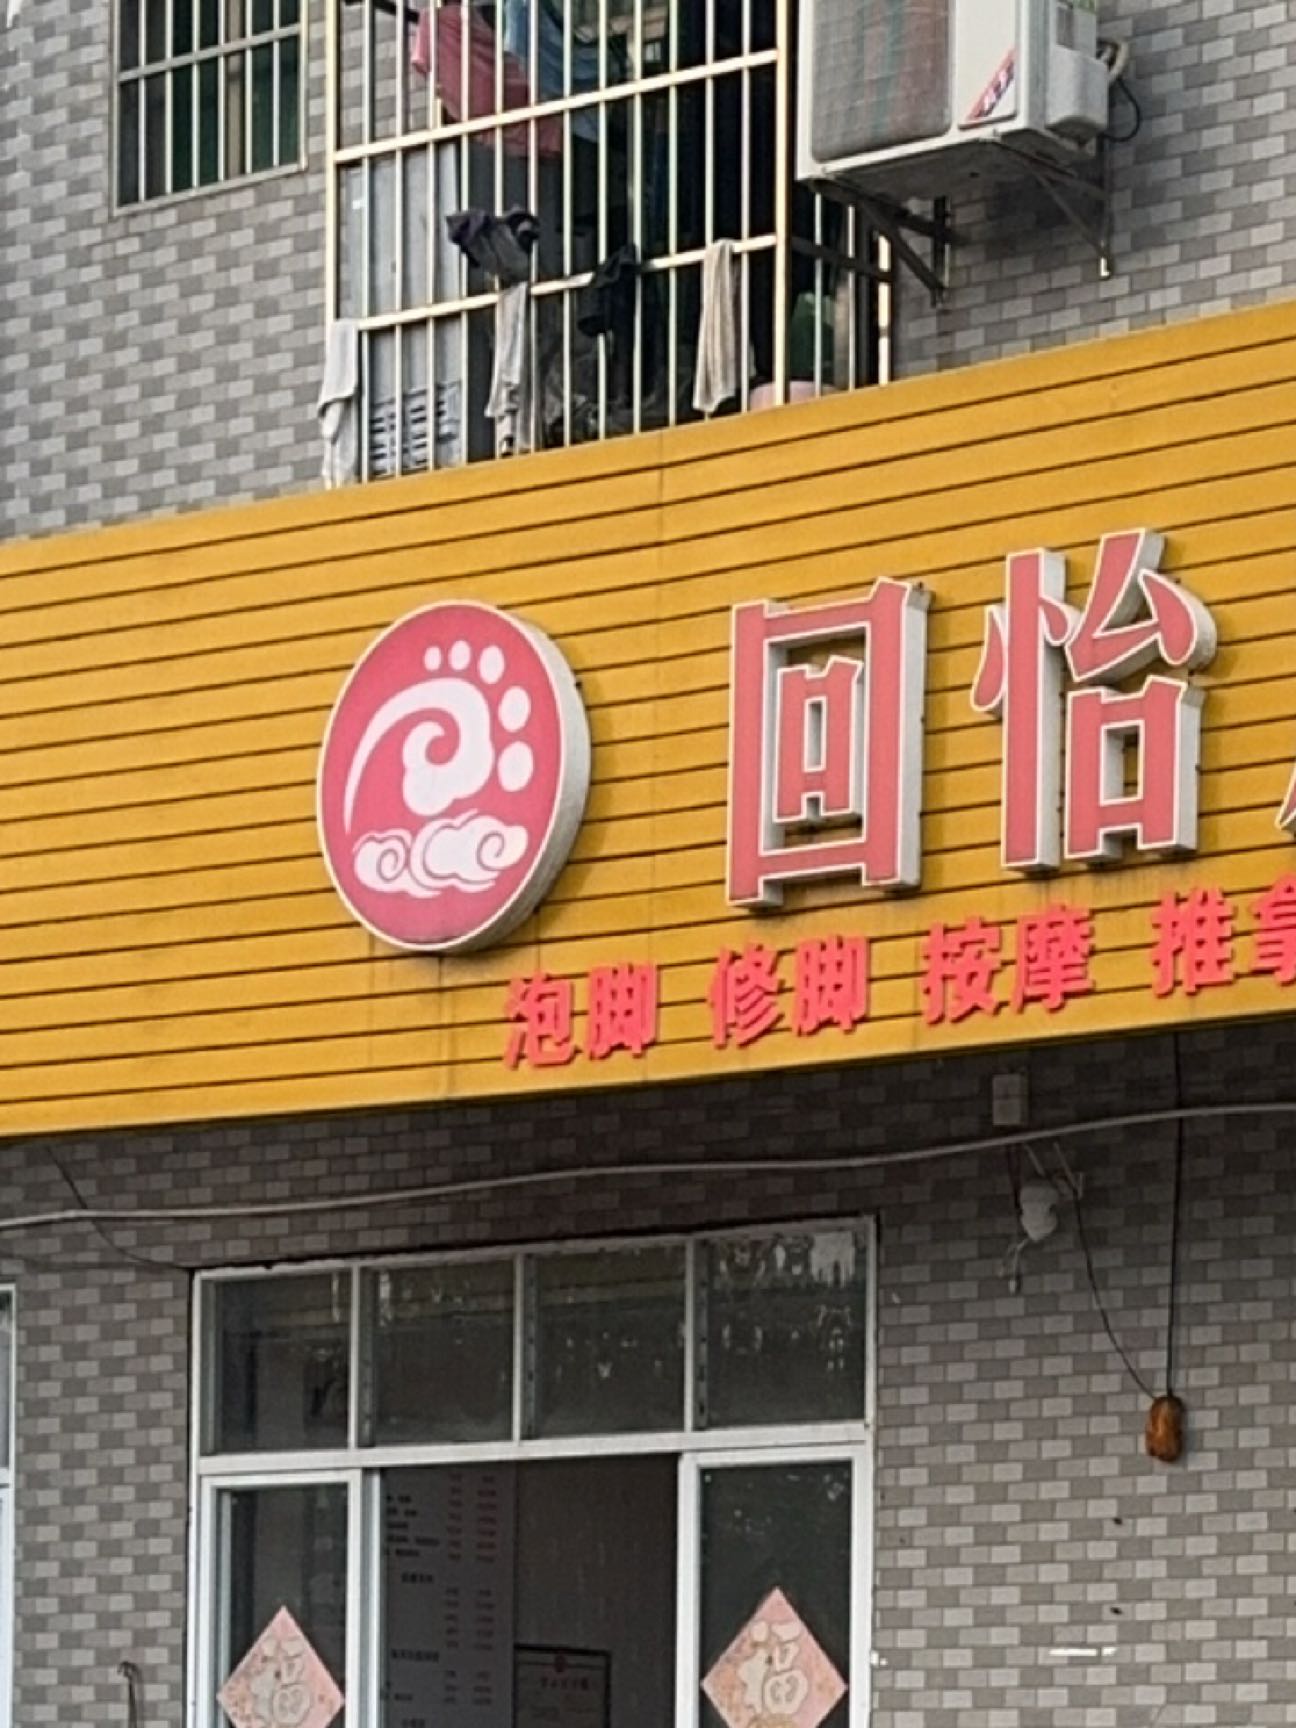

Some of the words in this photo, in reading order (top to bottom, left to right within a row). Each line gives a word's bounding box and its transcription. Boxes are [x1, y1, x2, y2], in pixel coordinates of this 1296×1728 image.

[502, 966, 660, 1070] 泡脚
[708, 934, 871, 1049] 修脚
[922, 901, 1096, 1025] 按摩
